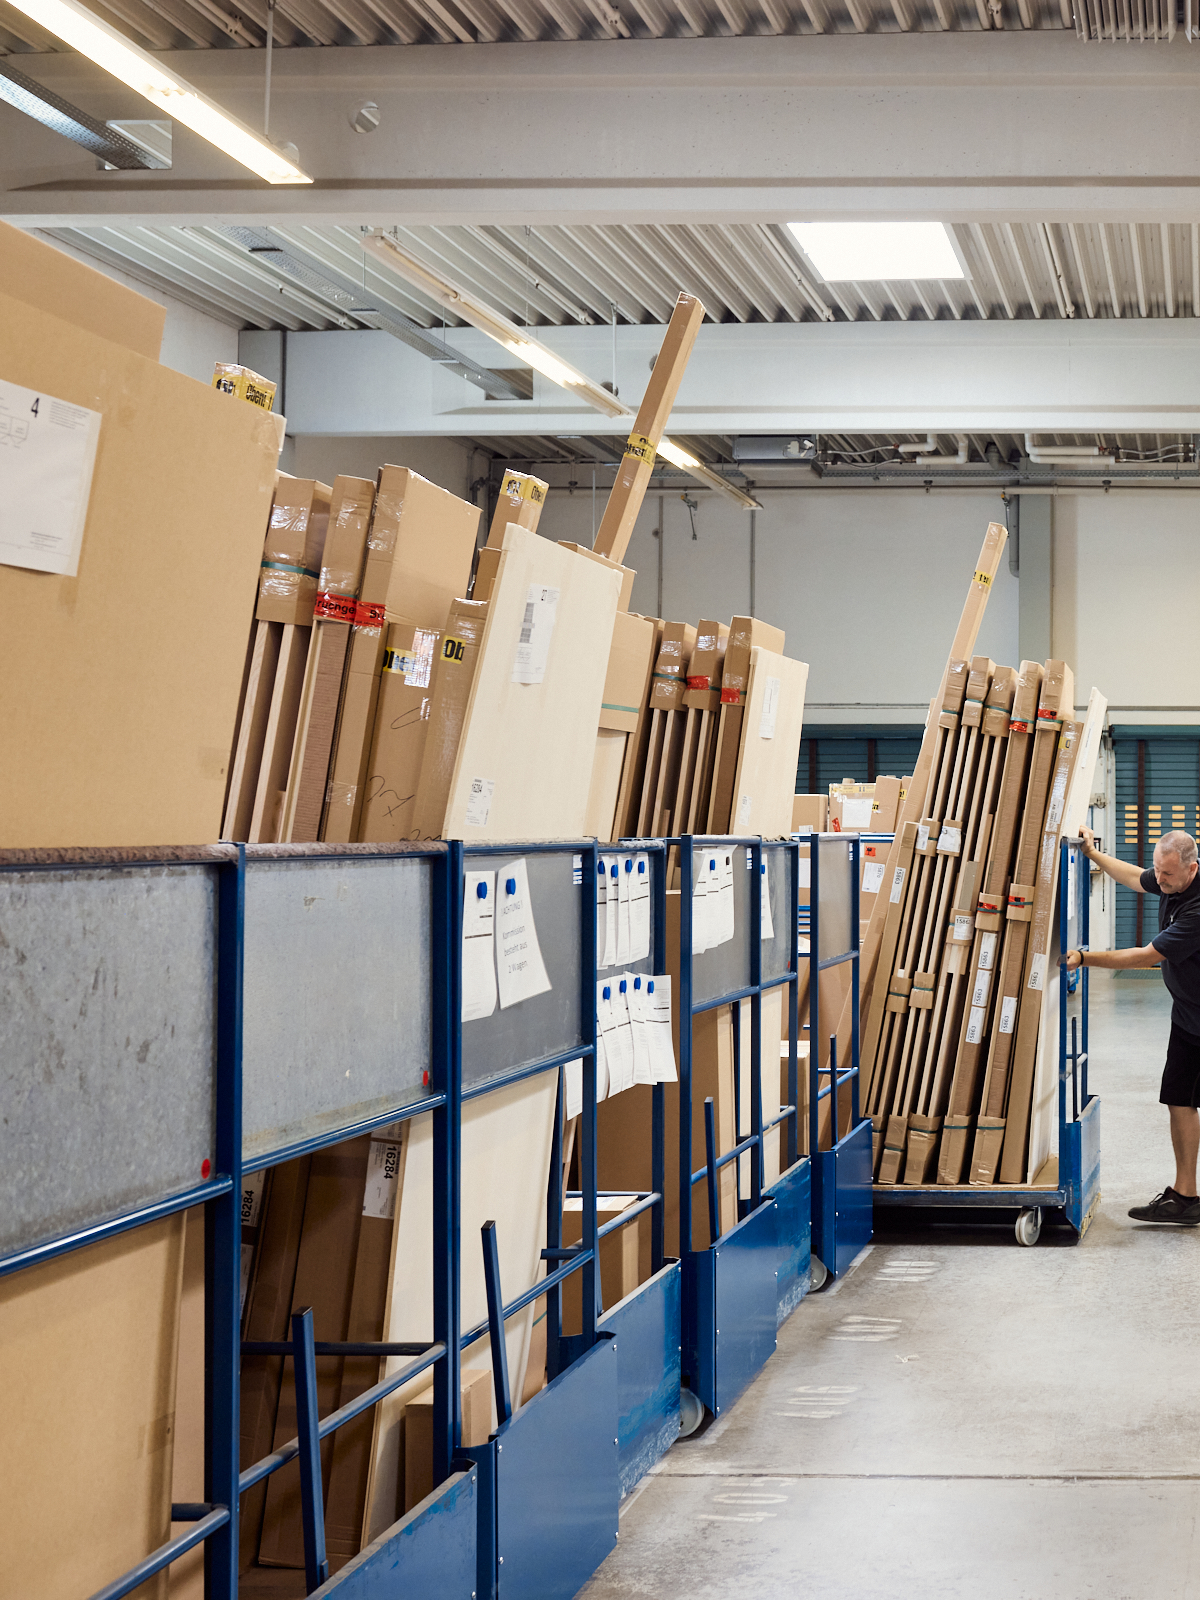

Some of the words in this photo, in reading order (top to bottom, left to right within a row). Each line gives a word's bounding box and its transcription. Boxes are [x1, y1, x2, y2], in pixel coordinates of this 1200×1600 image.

[30, 397, 40, 418] 4
[502, 925, 526, 940] Kommission
[504, 944, 519, 957] besteht
[512, 960, 528, 973] Wagen
[383, 1146, 397, 1180] 16284
[241, 1190, 254, 1224] 16284
[873, 1260, 938, 1283] 408
[827, 1314, 903, 1342] 407
[772, 1384, 859, 1420] 406
[697, 1477, 798, 1524] 405
